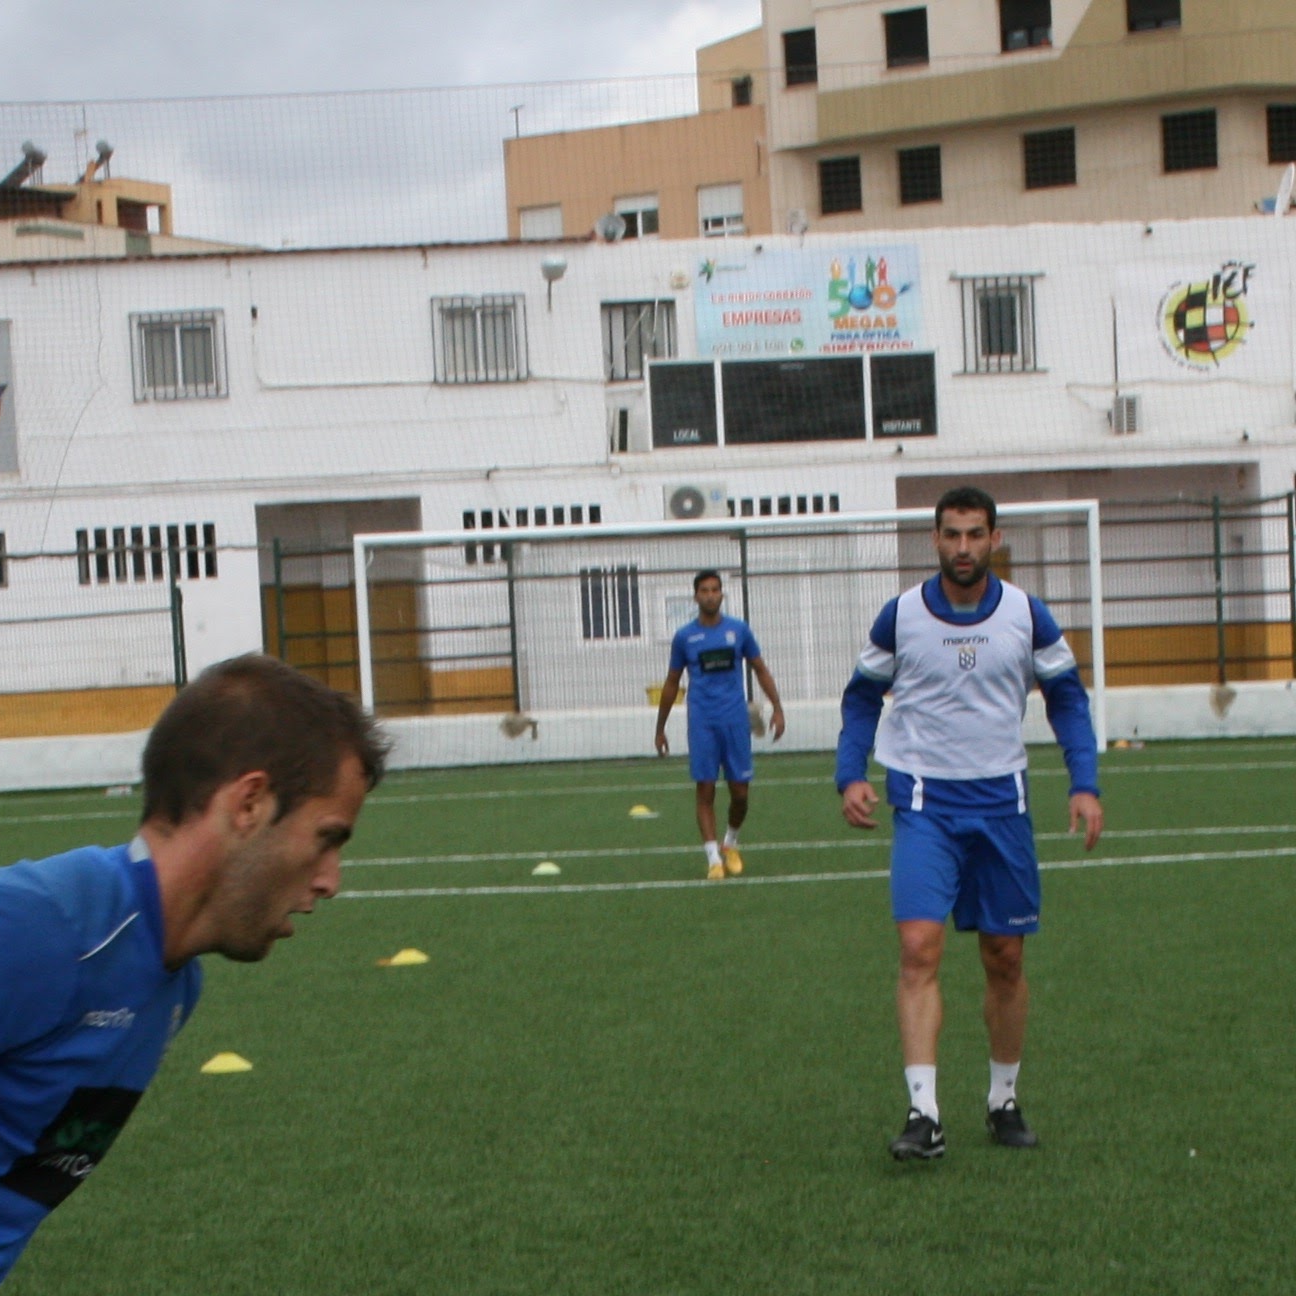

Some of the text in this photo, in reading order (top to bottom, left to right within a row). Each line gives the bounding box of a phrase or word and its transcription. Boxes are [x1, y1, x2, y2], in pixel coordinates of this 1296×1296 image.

[721, 308, 802, 328] EMPRESAS
[832, 314, 898, 331] MEGAS
[830, 330, 861, 342] FIBRA
[882, 418, 922, 433] VISITANTE
[672, 428, 701, 442] LOCAL
